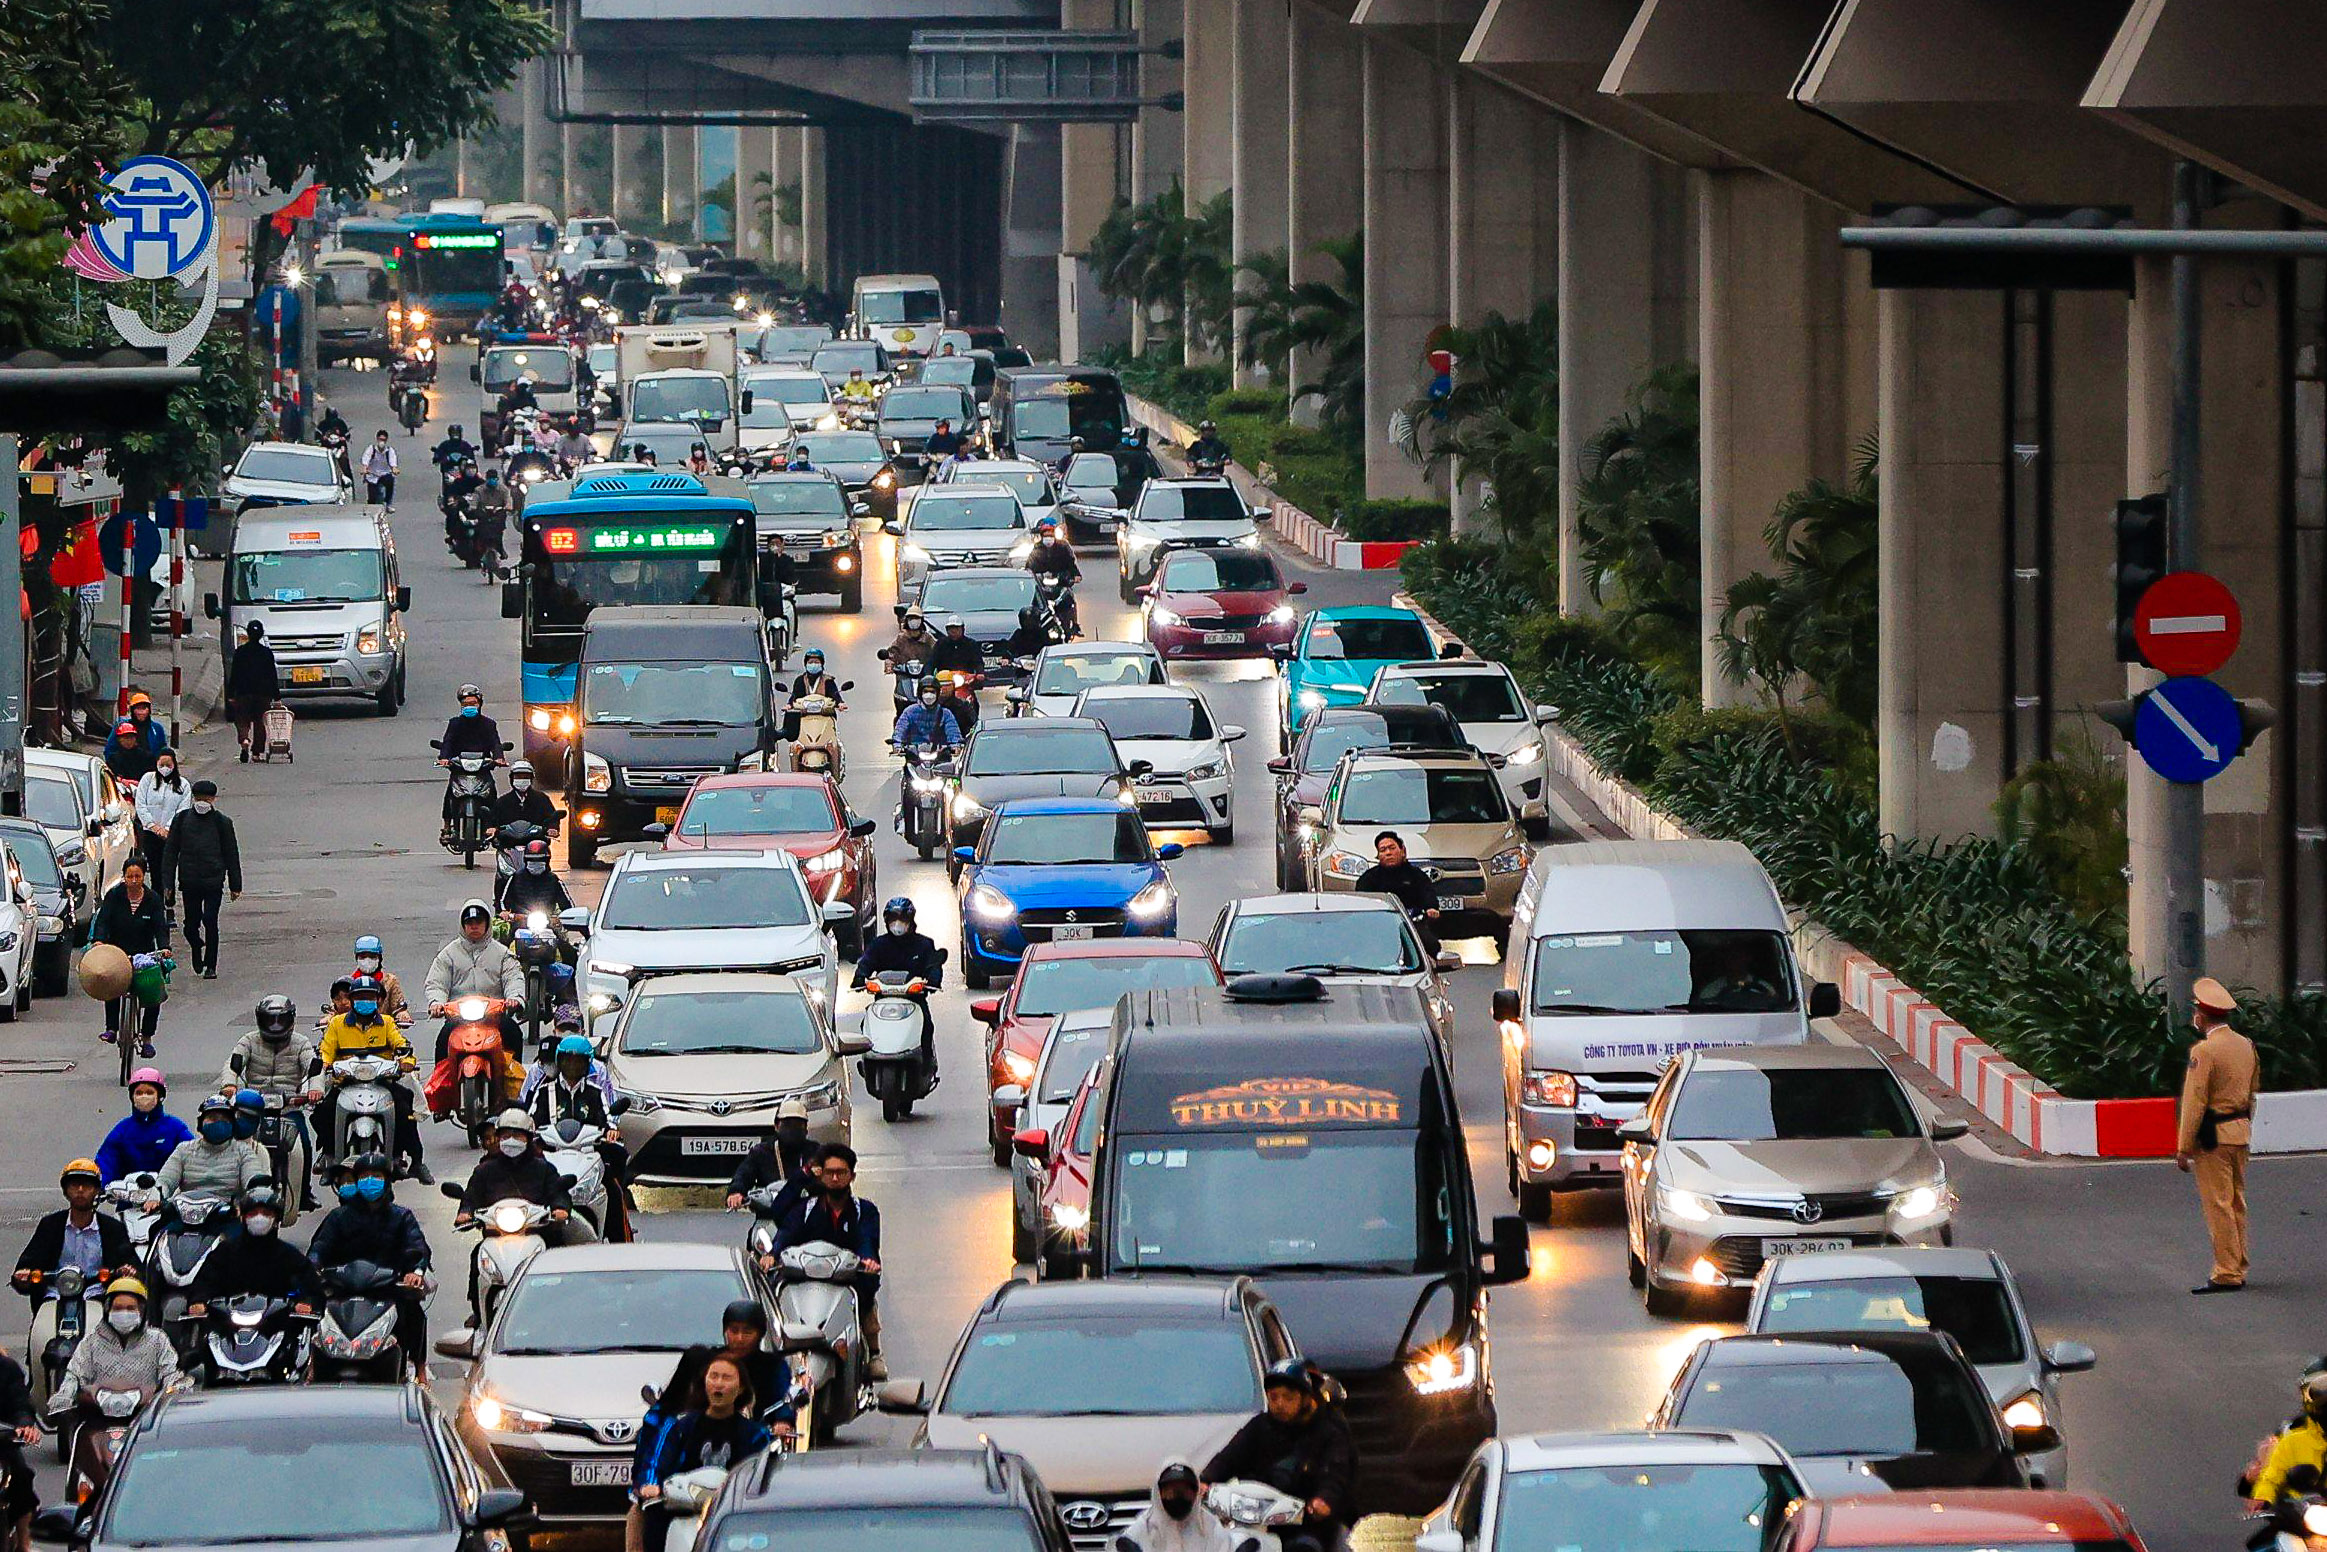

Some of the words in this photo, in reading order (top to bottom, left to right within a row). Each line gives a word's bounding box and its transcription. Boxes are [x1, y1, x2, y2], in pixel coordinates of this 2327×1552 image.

[550, 532, 575, 549] 02
[1584, 1043, 1605, 1059] CÔNG
[1607, 1044, 1617, 1058] TY
[1618, 1043, 1645, 1057] TOYOTA
[1646, 1043, 1658, 1056] VN
[1664, 1042, 1675, 1055] XE
[1300, 1099, 1402, 1121] LINH
